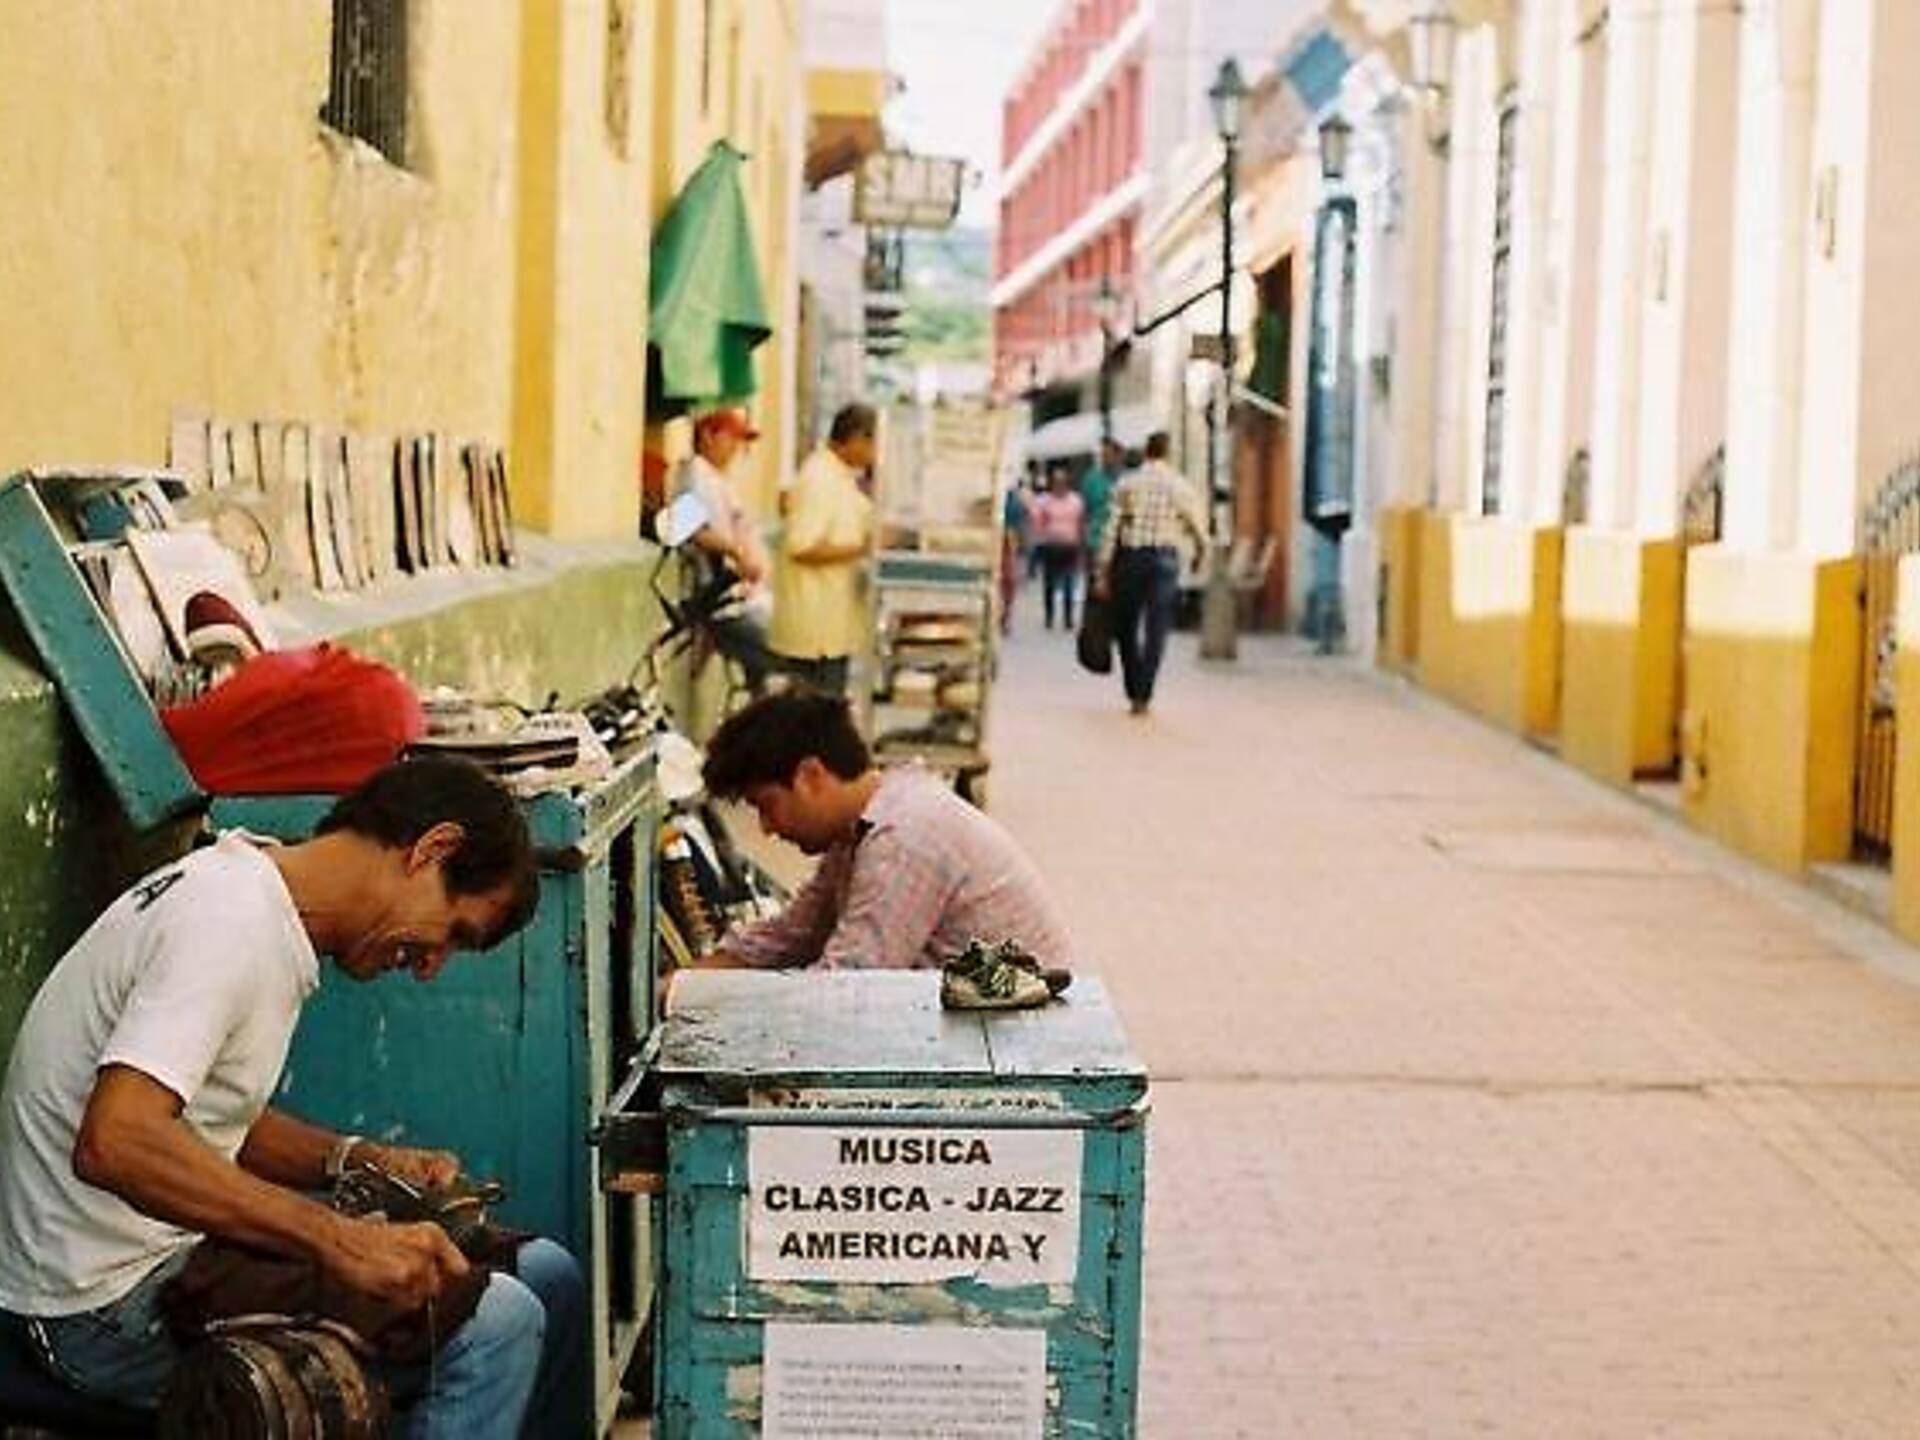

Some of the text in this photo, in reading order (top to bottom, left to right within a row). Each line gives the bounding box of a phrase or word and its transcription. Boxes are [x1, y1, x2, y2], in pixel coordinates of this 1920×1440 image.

[839, 1137, 992, 1165] MUSICA
[764, 1184, 930, 1213] CLASICA
[965, 1186, 1064, 1213] JAZZ
[779, 1231, 1047, 1262] AMERICANA Y
